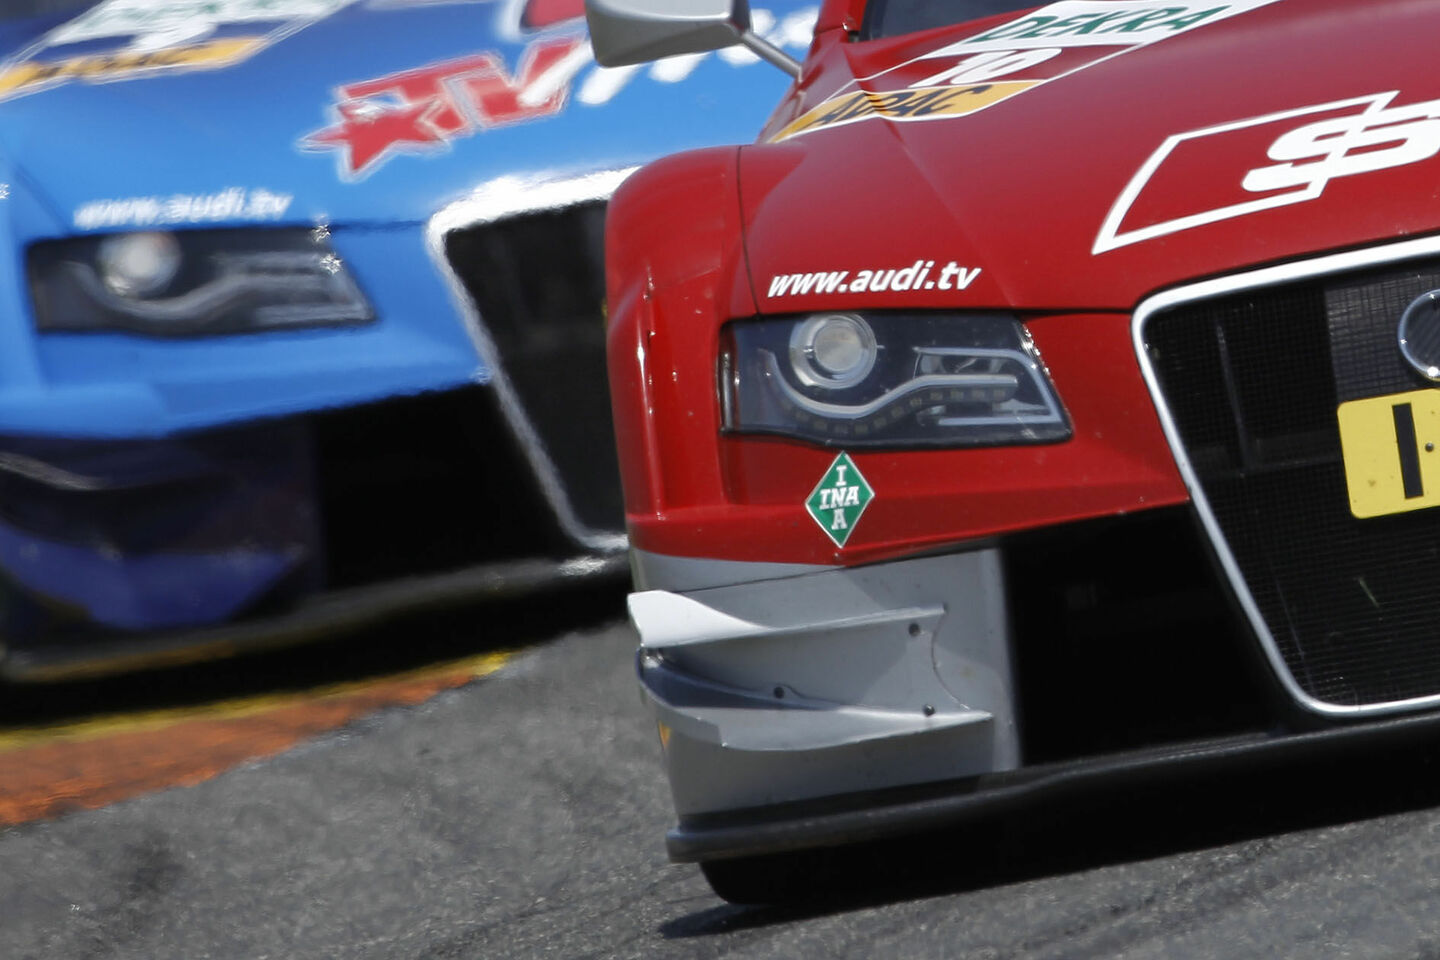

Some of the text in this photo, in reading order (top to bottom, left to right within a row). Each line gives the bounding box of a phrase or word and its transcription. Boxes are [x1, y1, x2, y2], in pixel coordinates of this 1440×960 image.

[968, 5, 1233, 43] DEKRA
[907, 46, 1063, 88] 10
[796, 84, 993, 133] ADAC
[767, 259, 983, 298] www.audi.tv
[1391, 401, 1425, 500] I
[819, 485, 860, 511] INA
